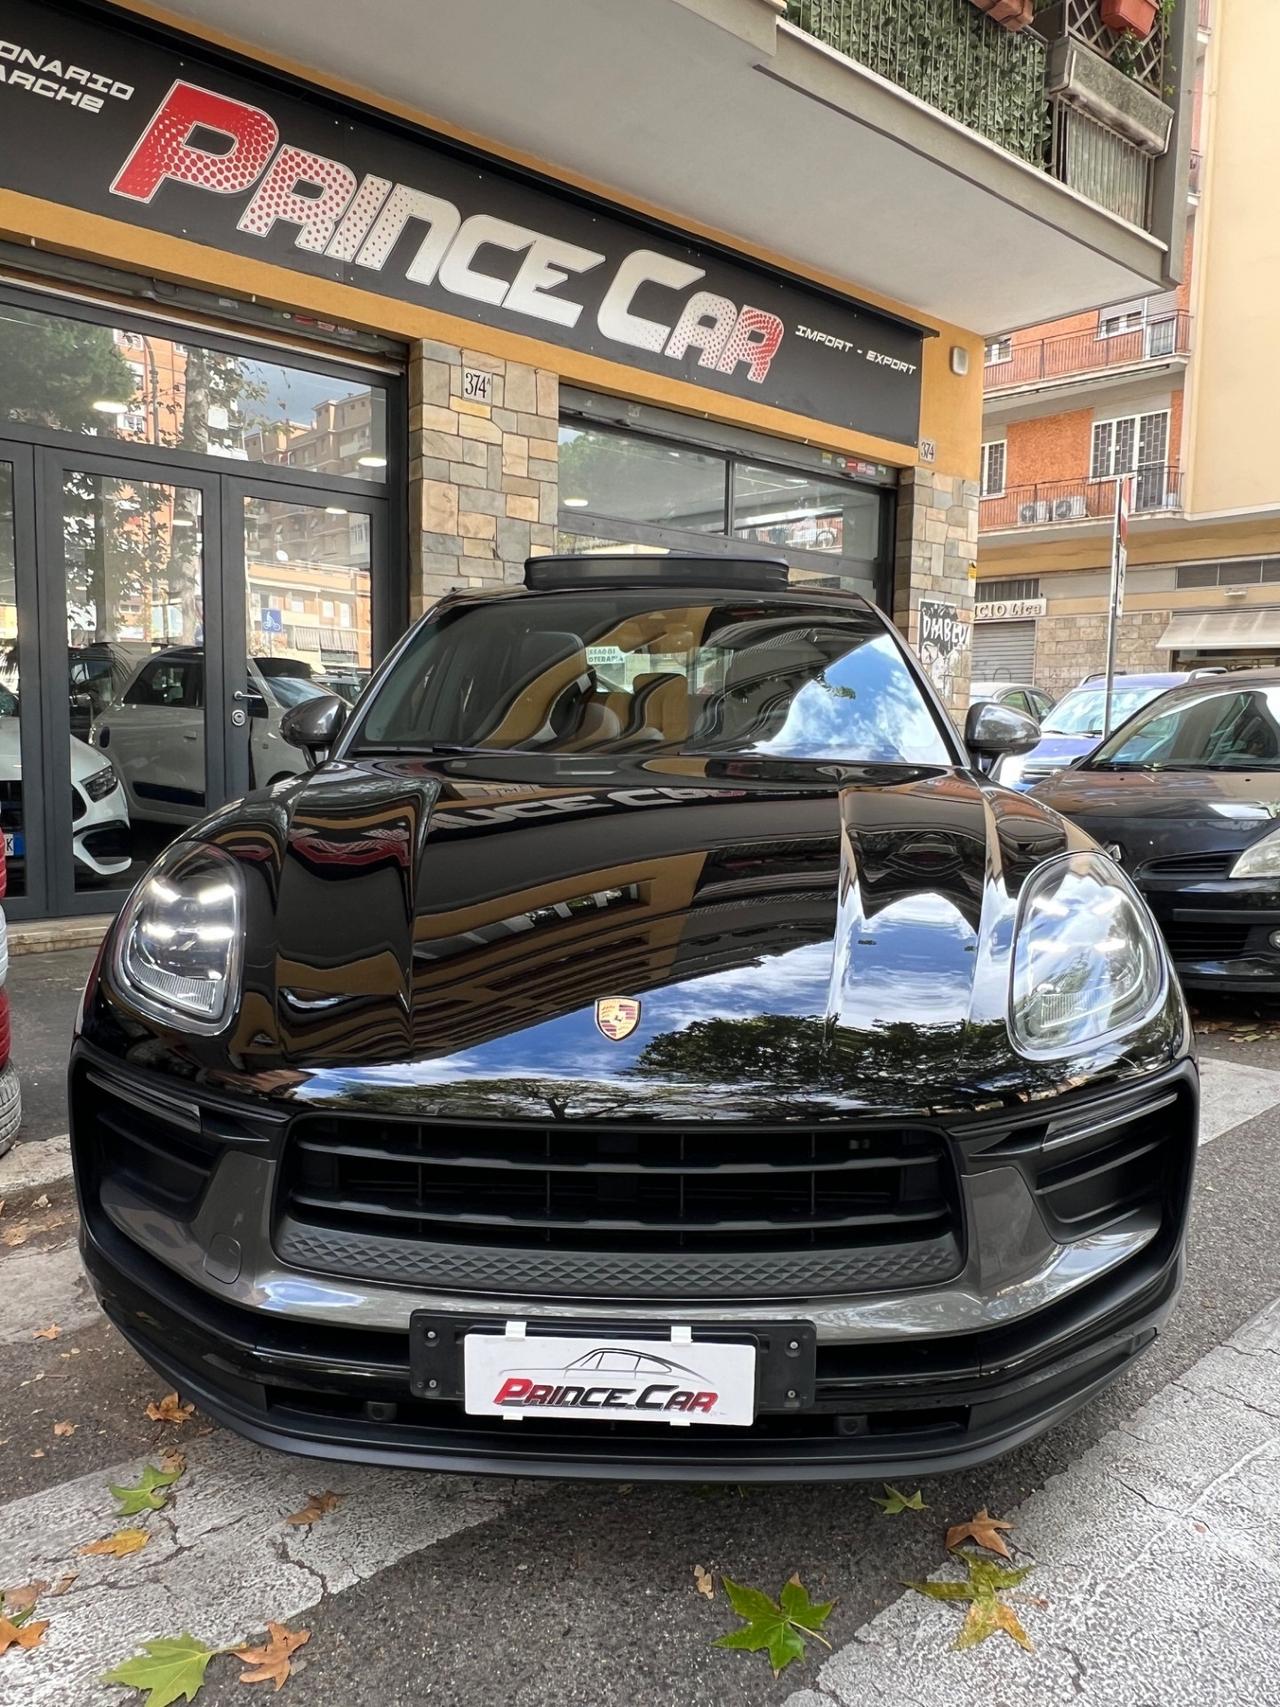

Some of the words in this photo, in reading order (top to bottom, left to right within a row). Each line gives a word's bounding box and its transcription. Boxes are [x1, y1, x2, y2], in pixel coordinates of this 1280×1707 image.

[109, 79, 606, 328] PRINCE
[597, 249, 785, 383] CAR
[795, 325, 853, 353] IMPORT
[866, 350, 916, 375] EXPORT
[920, 441, 934, 460] 374
